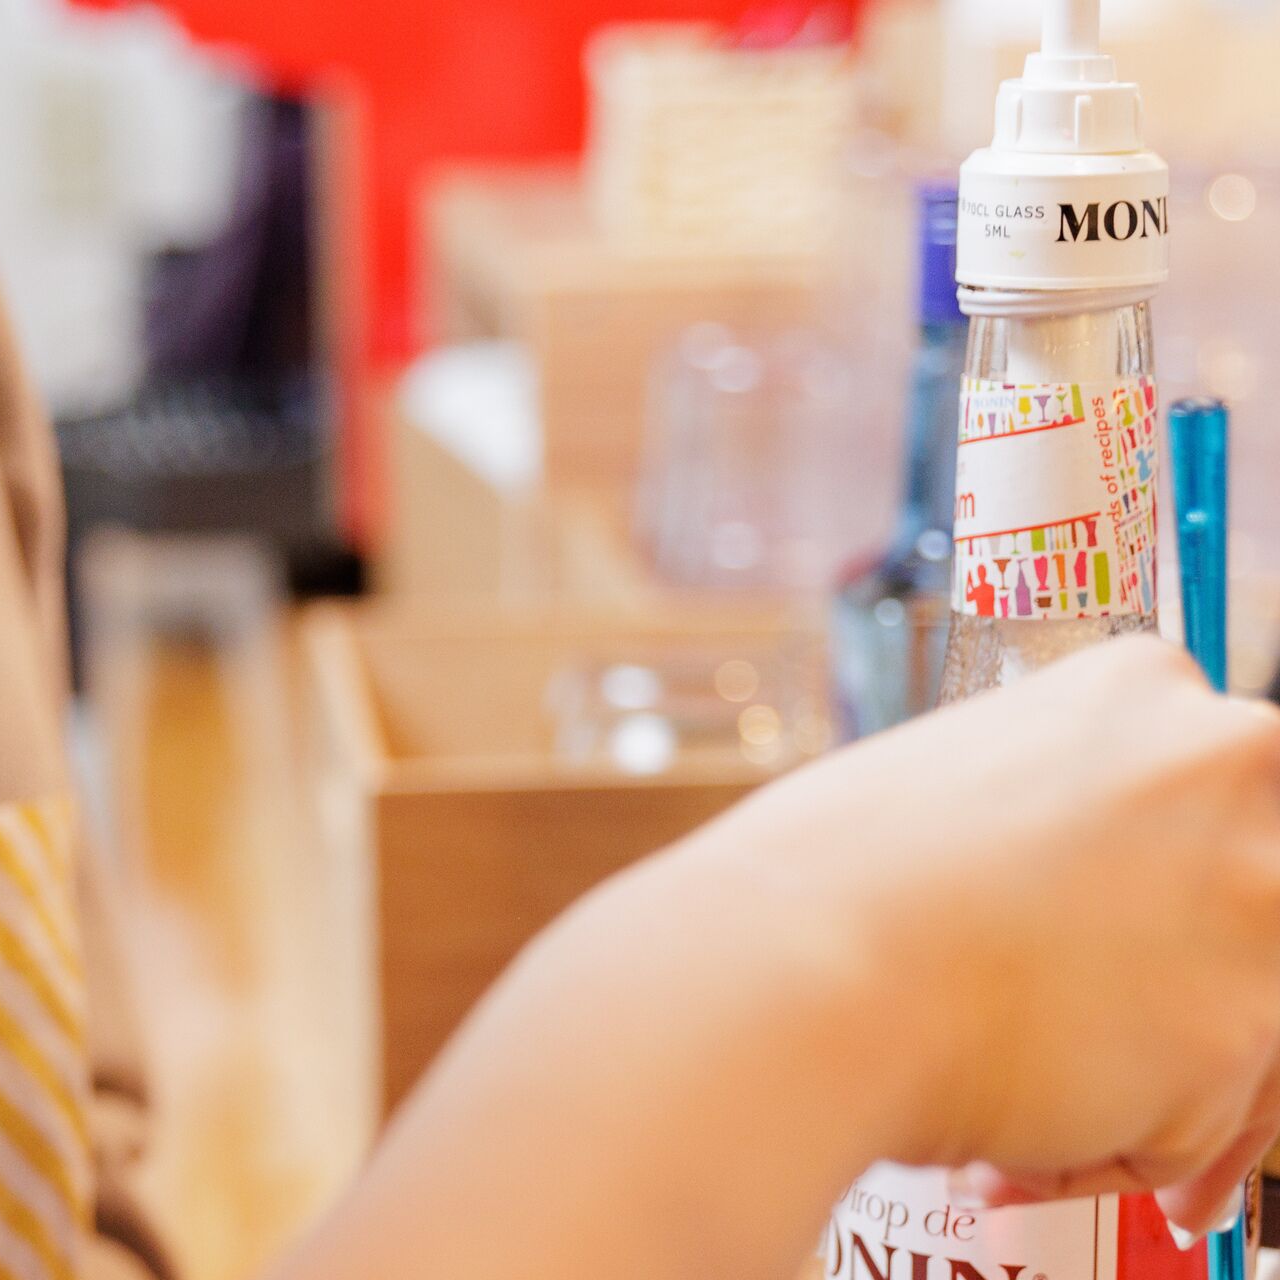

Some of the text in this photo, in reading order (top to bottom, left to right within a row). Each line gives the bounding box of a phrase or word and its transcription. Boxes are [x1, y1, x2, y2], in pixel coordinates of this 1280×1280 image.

[995, 204, 1045, 219] GLASS
[984, 223, 1011, 238] 5ML
[1092, 396, 1116, 469] recipes
[1100, 473, 1119, 495] of
[923, 1204, 976, 1242] de
